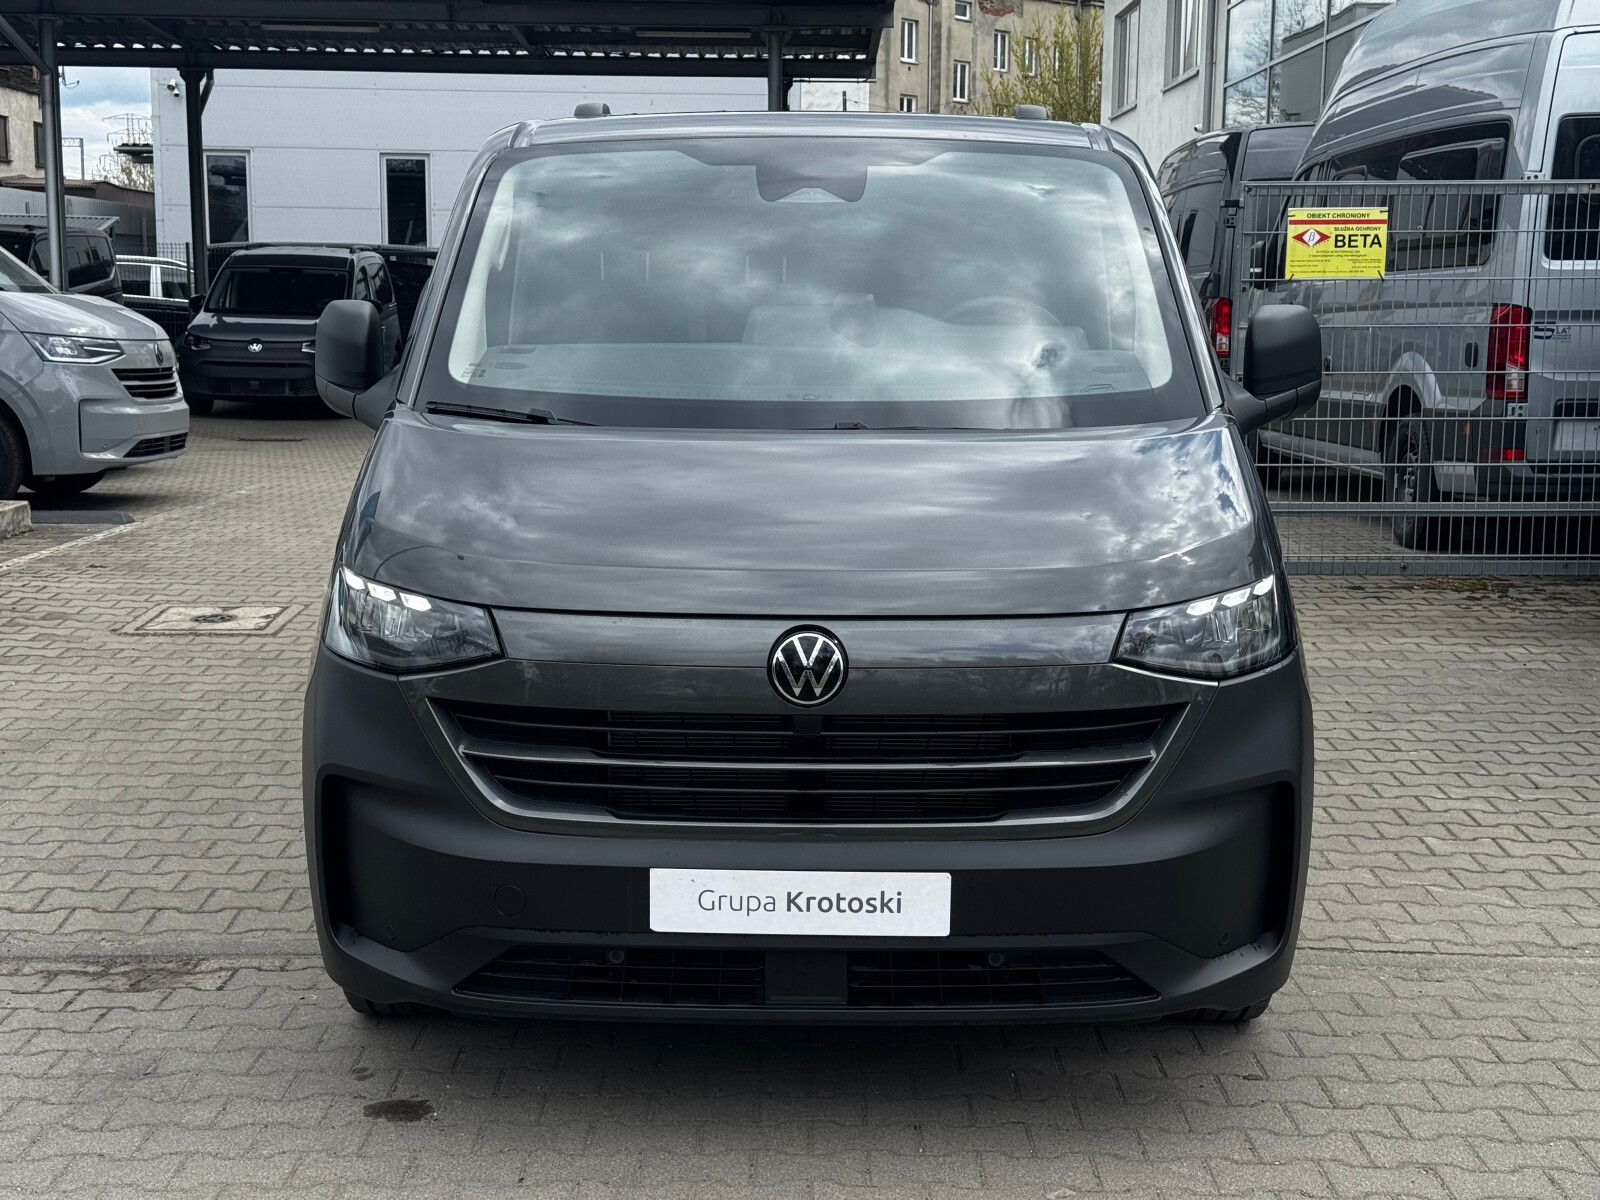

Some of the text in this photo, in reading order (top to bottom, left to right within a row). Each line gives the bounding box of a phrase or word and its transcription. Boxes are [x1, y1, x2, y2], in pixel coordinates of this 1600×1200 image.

[1334, 234, 1382, 248] BETA
[698, 889, 902, 916] Grupa Krotoski
